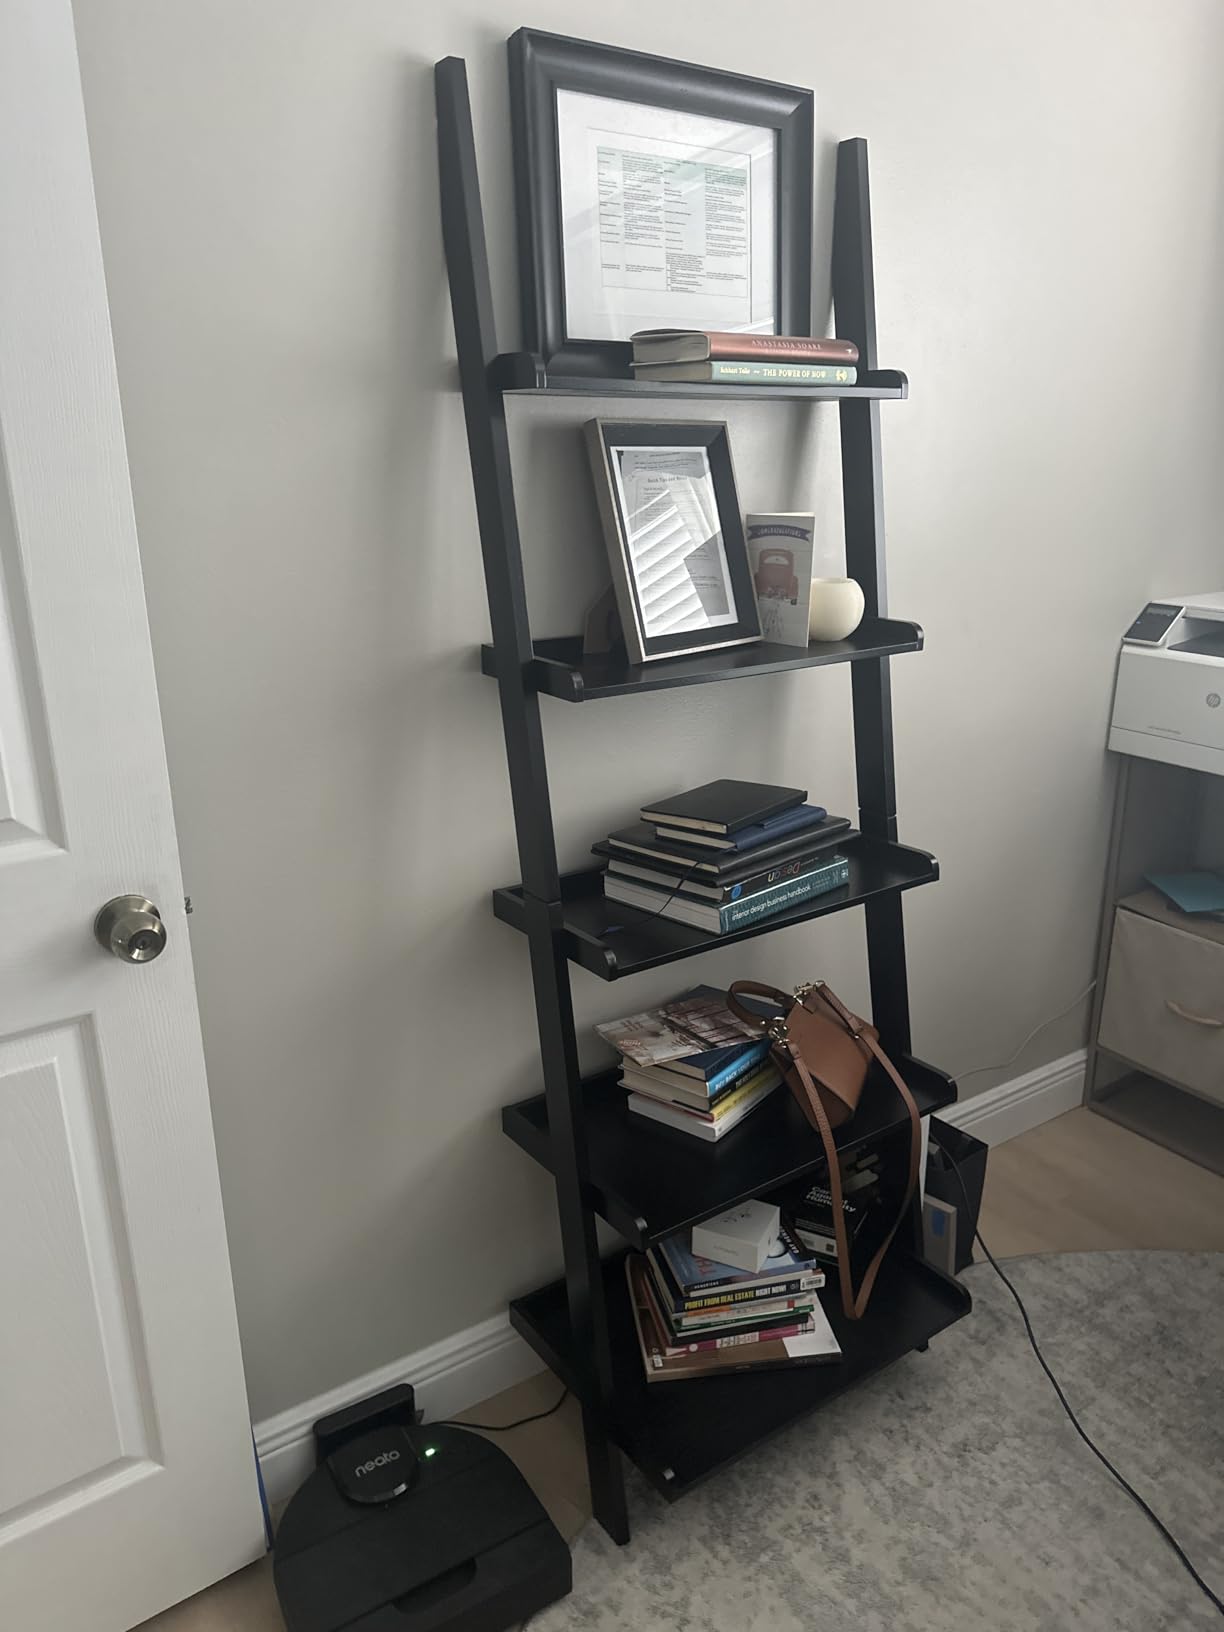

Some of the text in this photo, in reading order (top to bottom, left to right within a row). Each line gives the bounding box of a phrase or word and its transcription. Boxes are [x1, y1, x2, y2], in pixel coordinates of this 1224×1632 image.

[763, 369, 777, 377] THE
[779, 369, 801, 378] POWER
[802, 370, 811, 378] OF
[812, 370, 827, 379] NOW
[750, 902, 767, 915] design
[766, 895, 788, 907] business
[787, 884, 812, 899] handbook
[703, 1297, 720, 1307] FROM
[720, 1294, 734, 1304] REAL
[734, 1290, 755, 1301] ESTATE
[354, 1449, 401, 1478] neato
